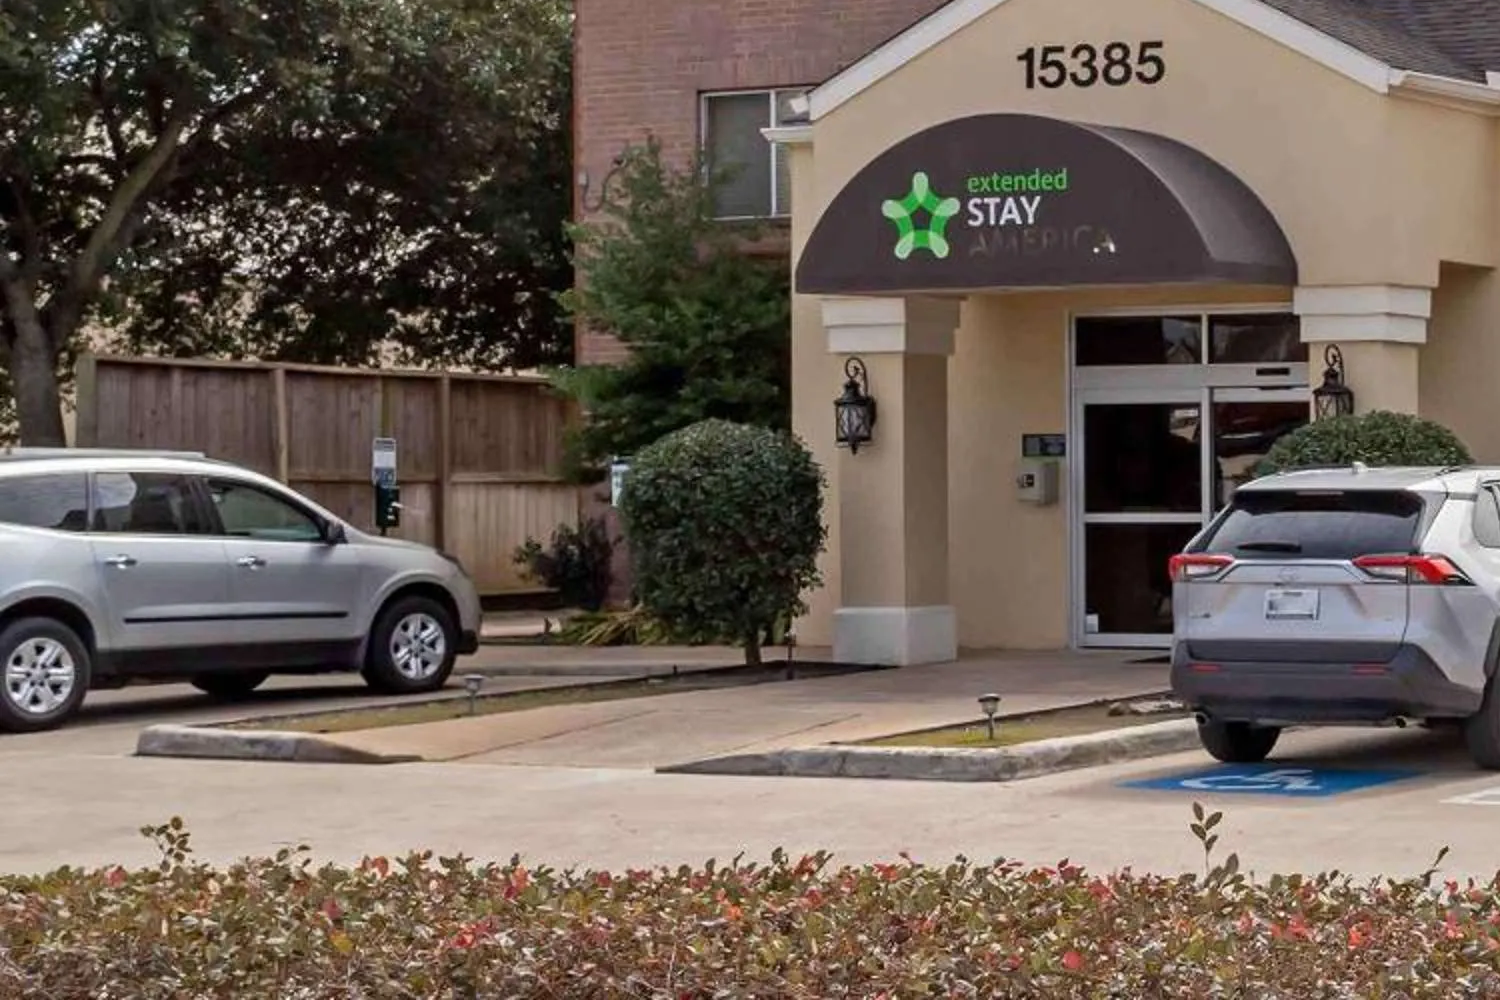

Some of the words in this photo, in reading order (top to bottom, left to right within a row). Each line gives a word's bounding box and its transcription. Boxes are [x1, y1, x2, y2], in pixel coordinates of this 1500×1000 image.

[1017, 41, 1165, 89] 15385
[967, 169, 1067, 192] extended
[967, 196, 1042, 227] STAY
